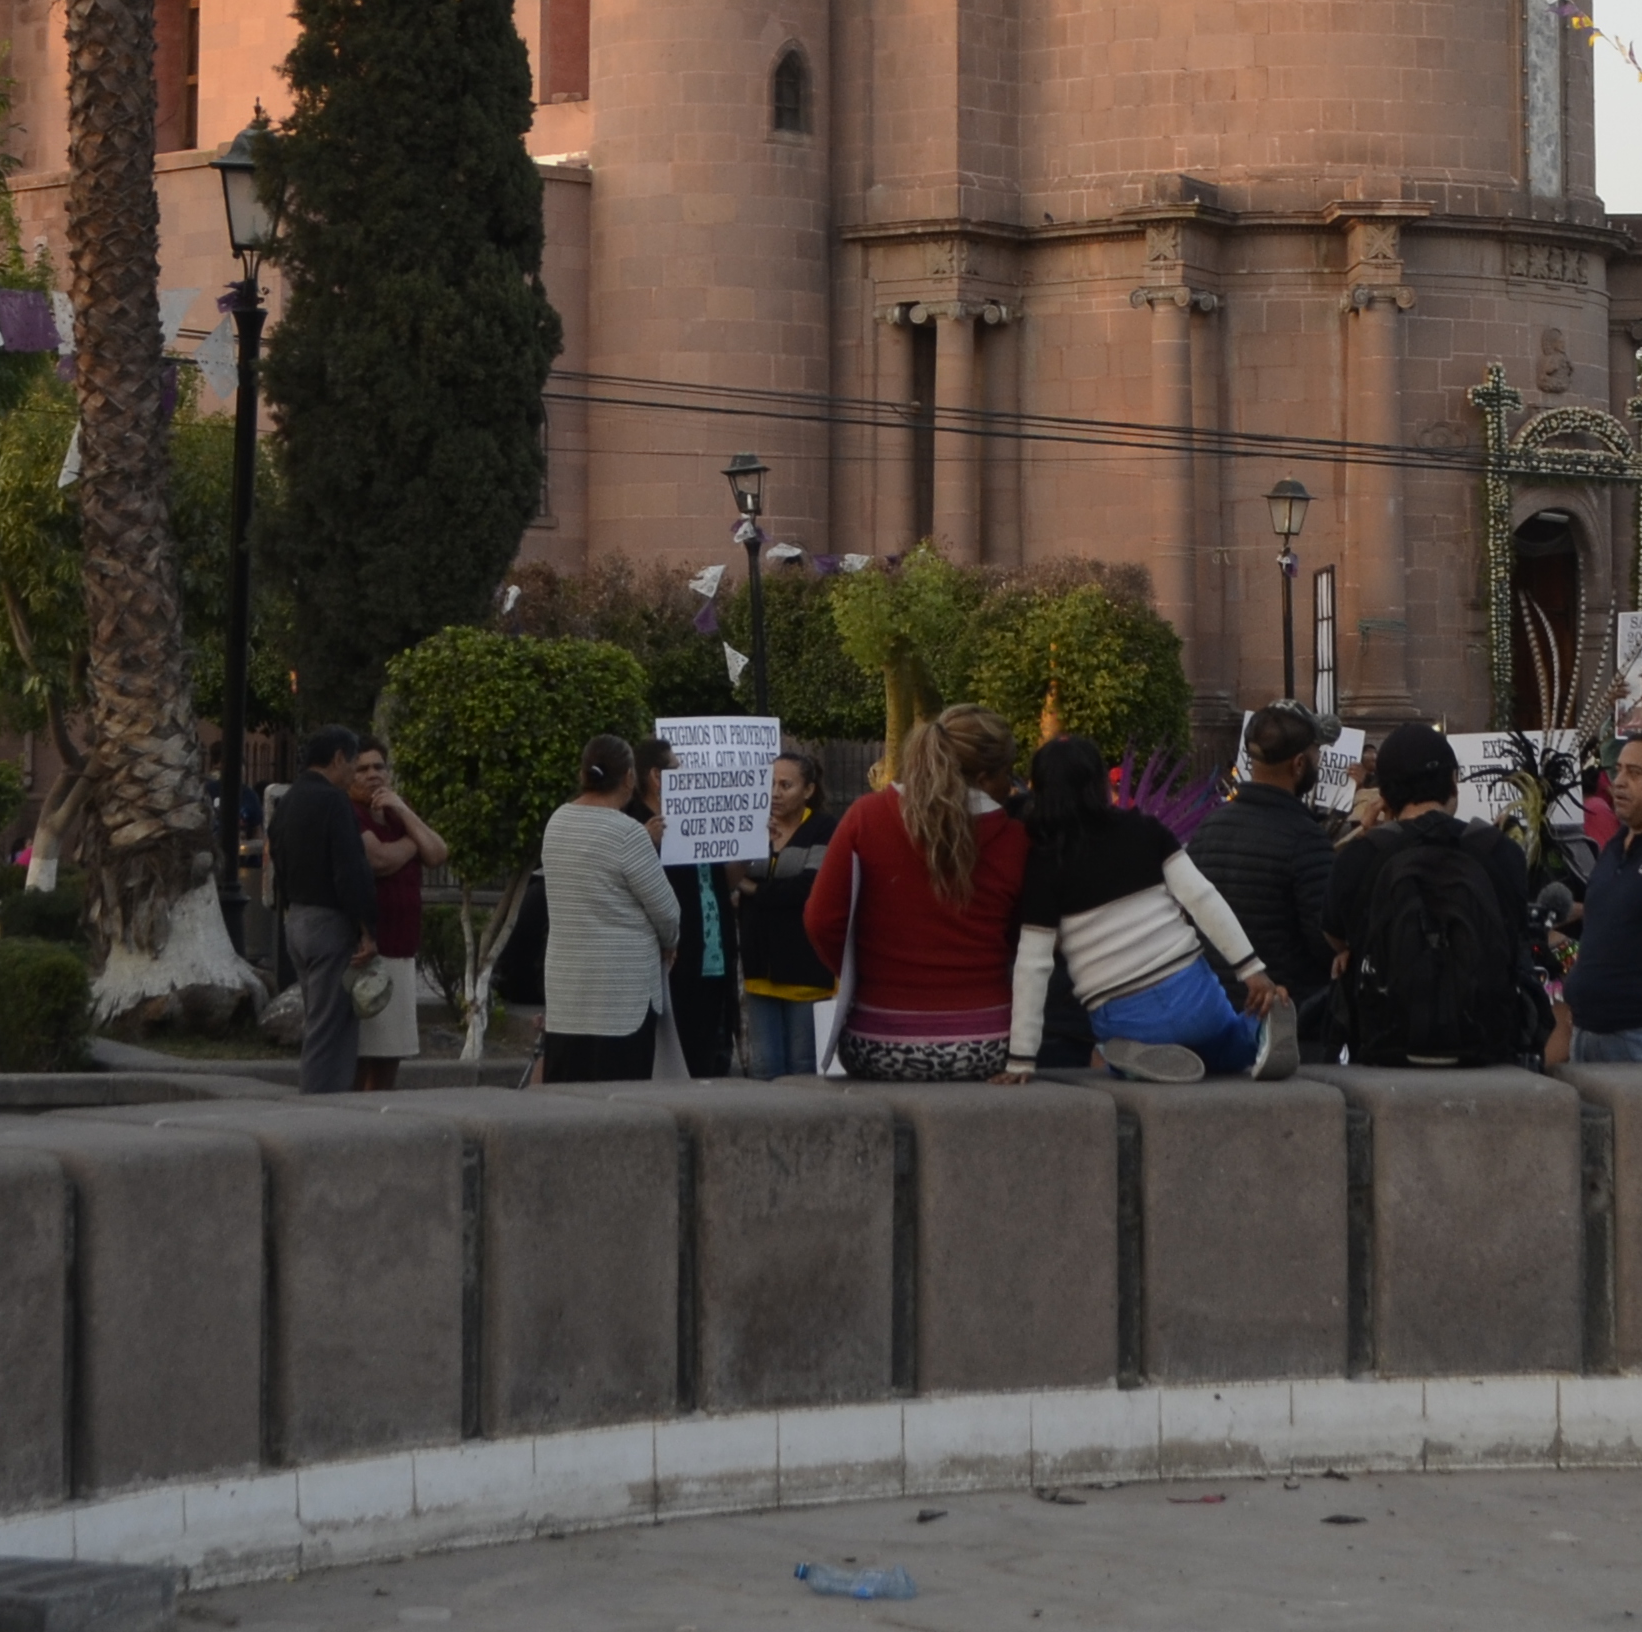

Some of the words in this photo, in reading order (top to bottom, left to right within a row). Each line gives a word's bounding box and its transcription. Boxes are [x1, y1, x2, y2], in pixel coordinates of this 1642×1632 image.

[660, 726, 711, 746] EXIGIMOS
[713, 724, 727, 746] UN
[730, 724, 777, 747] PROYECTO
[716, 751, 735, 768] QUE
[738, 751, 754, 767] NO
[669, 770, 756, 791] DEFENDEMOS
[759, 769, 768, 786] Y
[666, 793, 750, 816] PROTEGEMOS
[753, 792, 769, 810] LO
[1476, 785, 1483, 803] Y
[681, 818, 707, 837] QUE
[711, 816, 735, 835] NOS
[739, 815, 754, 832] ES
[694, 839, 739, 859] PROPIO
